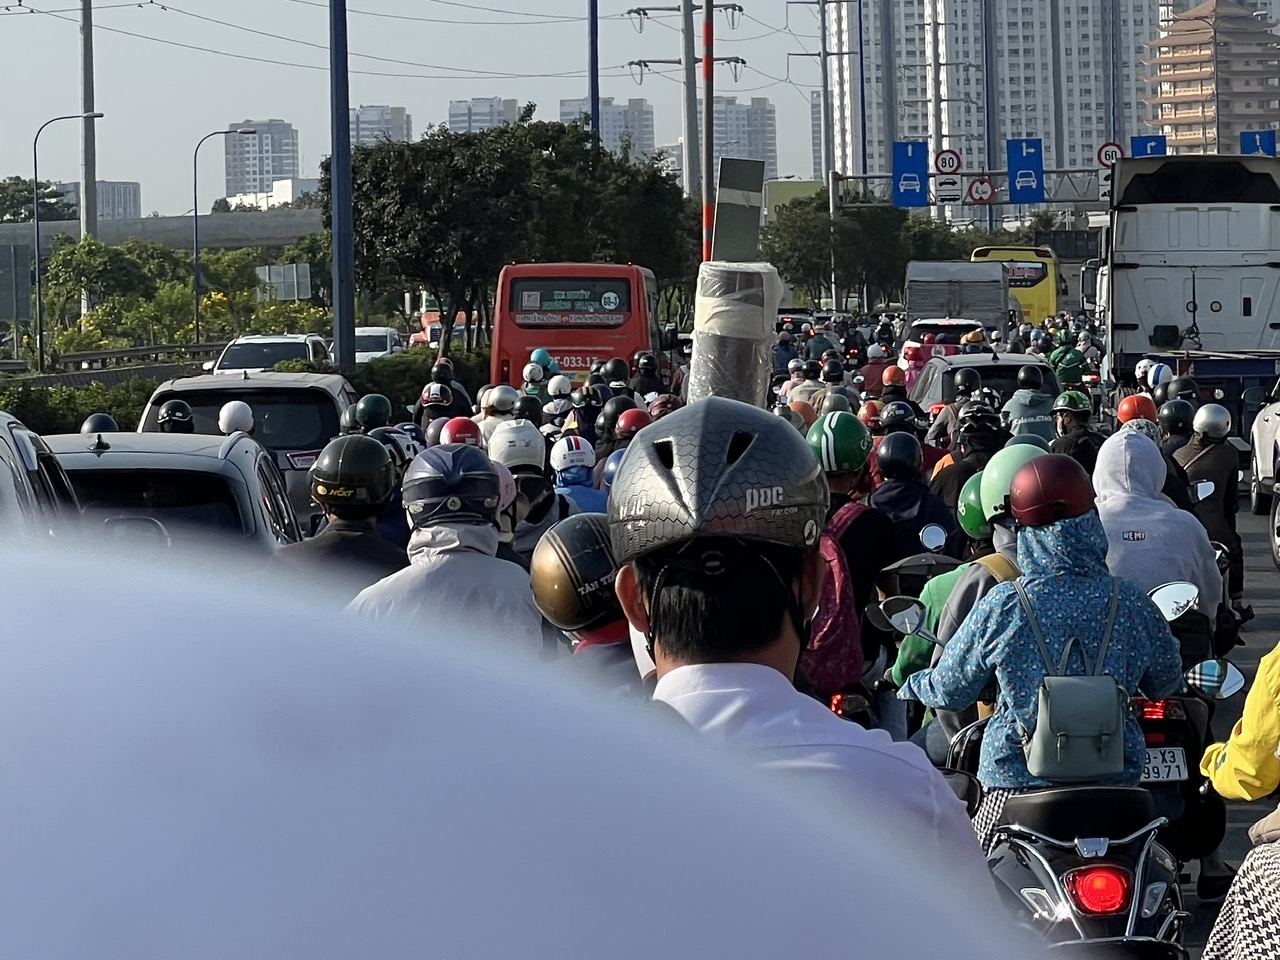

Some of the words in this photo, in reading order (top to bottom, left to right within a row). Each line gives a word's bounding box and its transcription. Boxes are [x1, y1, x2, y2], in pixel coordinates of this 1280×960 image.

[1104, 150, 1117, 161] 60
[941, 157, 954, 169] 80
[1145, 750, 1176, 765] 9-X3
[1144, 765, 1181, 779] 99.71
